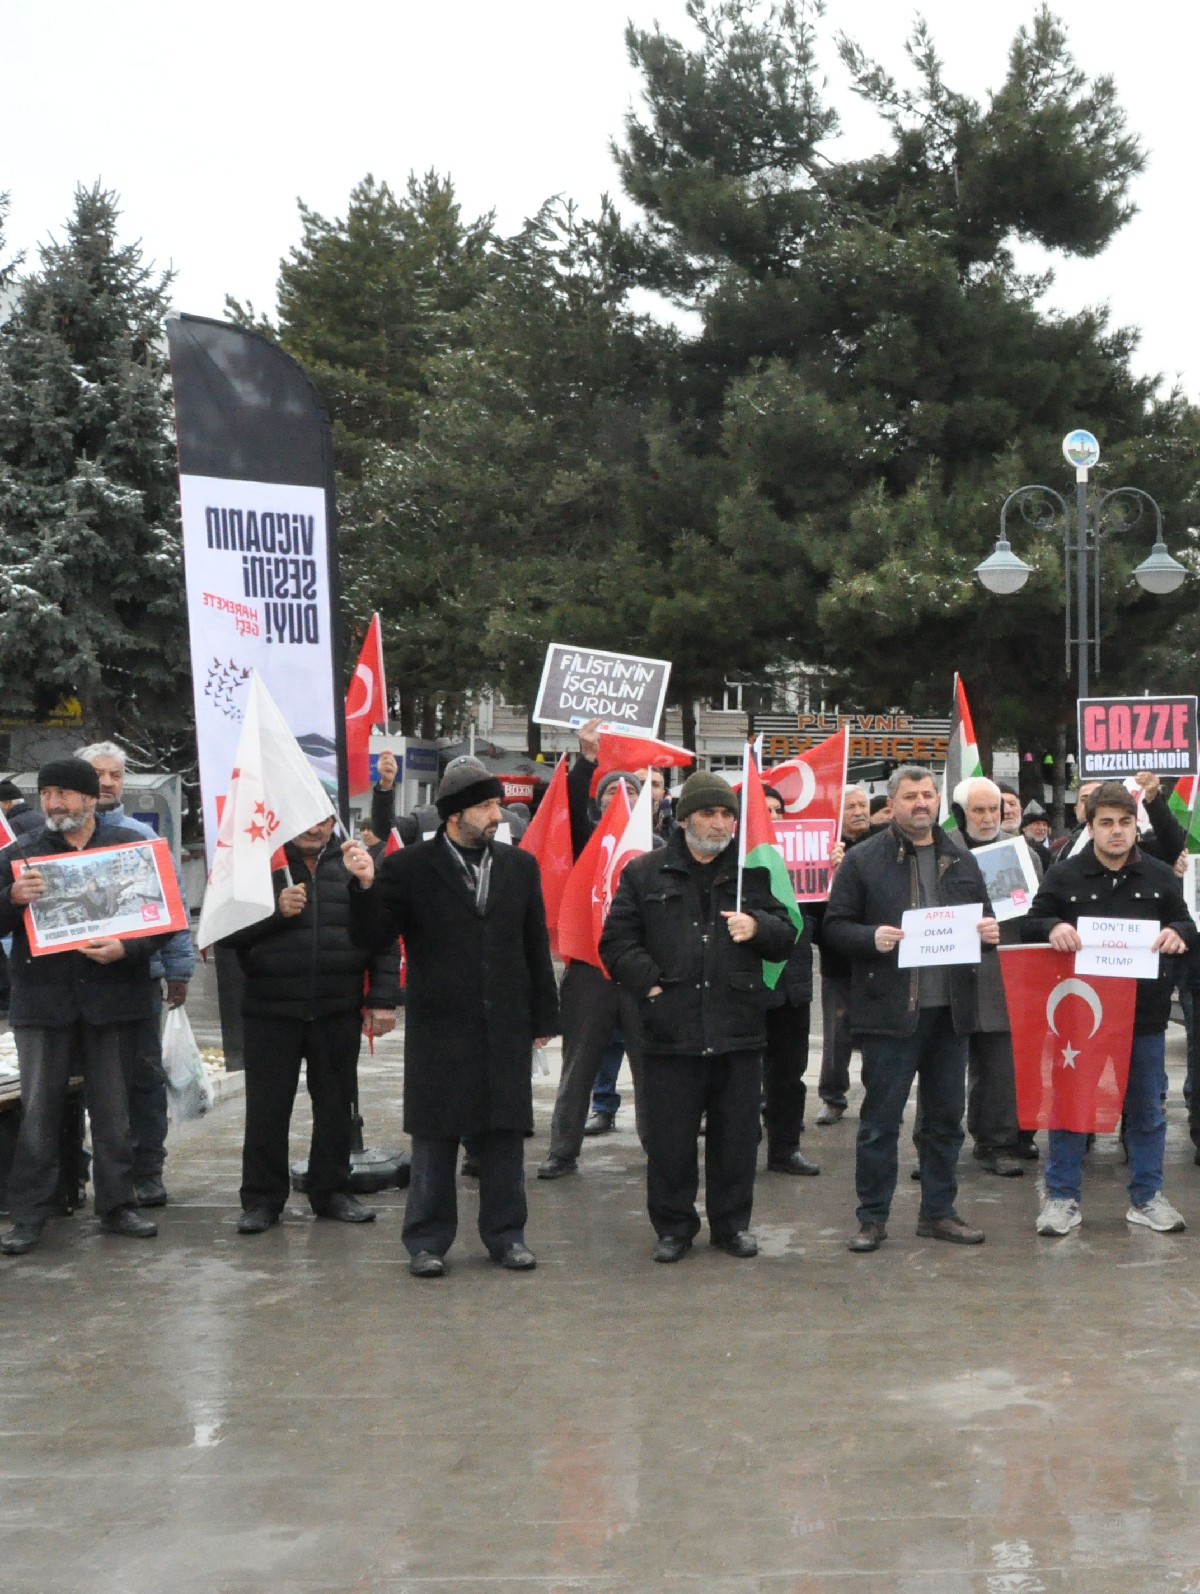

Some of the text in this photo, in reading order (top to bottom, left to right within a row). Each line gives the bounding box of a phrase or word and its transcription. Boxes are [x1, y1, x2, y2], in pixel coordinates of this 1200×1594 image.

[560, 653, 655, 682] FİLİSTİN'İN
[563, 671, 646, 701] İŞGALİNİ
[559, 692, 639, 720] DURDUR
[797, 714, 914, 731] PLEVNE
[1084, 704, 1189, 751] GAZZE
[851, 737, 950, 761] AHÇES
[1085, 749, 1190, 771] GAZZELİLERİNDİR
[925, 911, 956, 920] APTAL
[924, 927, 954, 937] OLMA
[1092, 922, 1141, 933] DON'T BE
[920, 944, 956, 954] TRUMP
[1102, 940, 1129, 949] FOOL
[1095, 956, 1133, 966] TRUMP
